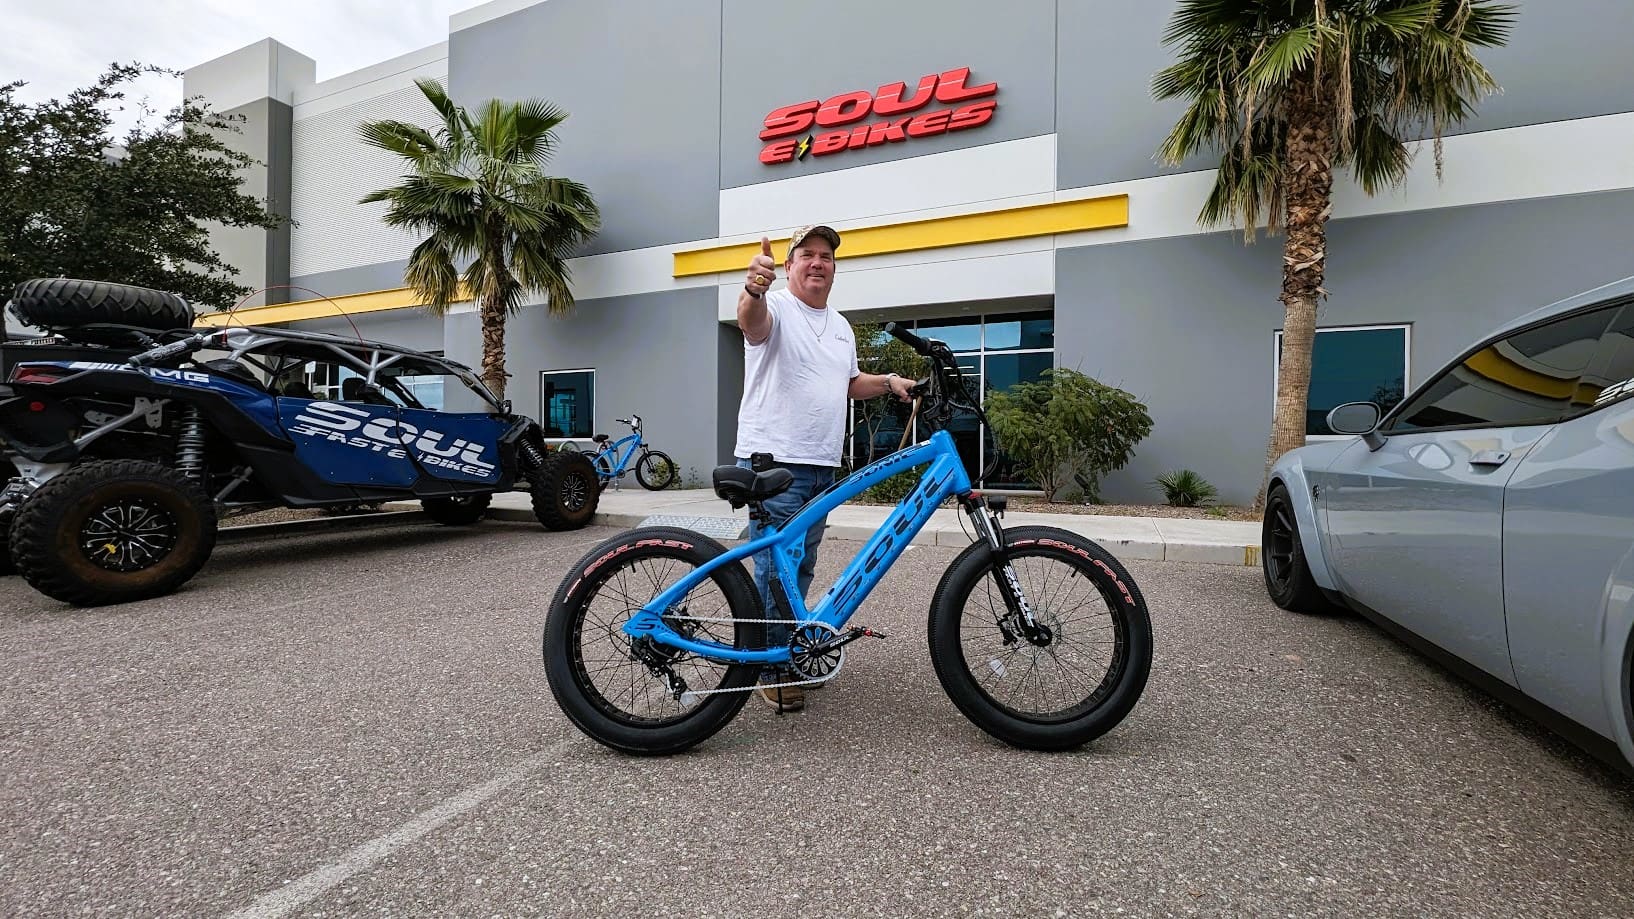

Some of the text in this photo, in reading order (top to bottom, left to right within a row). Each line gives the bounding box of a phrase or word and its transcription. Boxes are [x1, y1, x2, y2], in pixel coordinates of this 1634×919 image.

[758, 67, 997, 141] SOUL
[811, 100, 997, 157] BIKES
[288, 423, 391, 452] FAST
[423, 455, 491, 478] BIKES
[295, 401, 496, 470] SOUL
[833, 468, 954, 616] SOUL
[1037, 538, 1093, 561] SOUL
